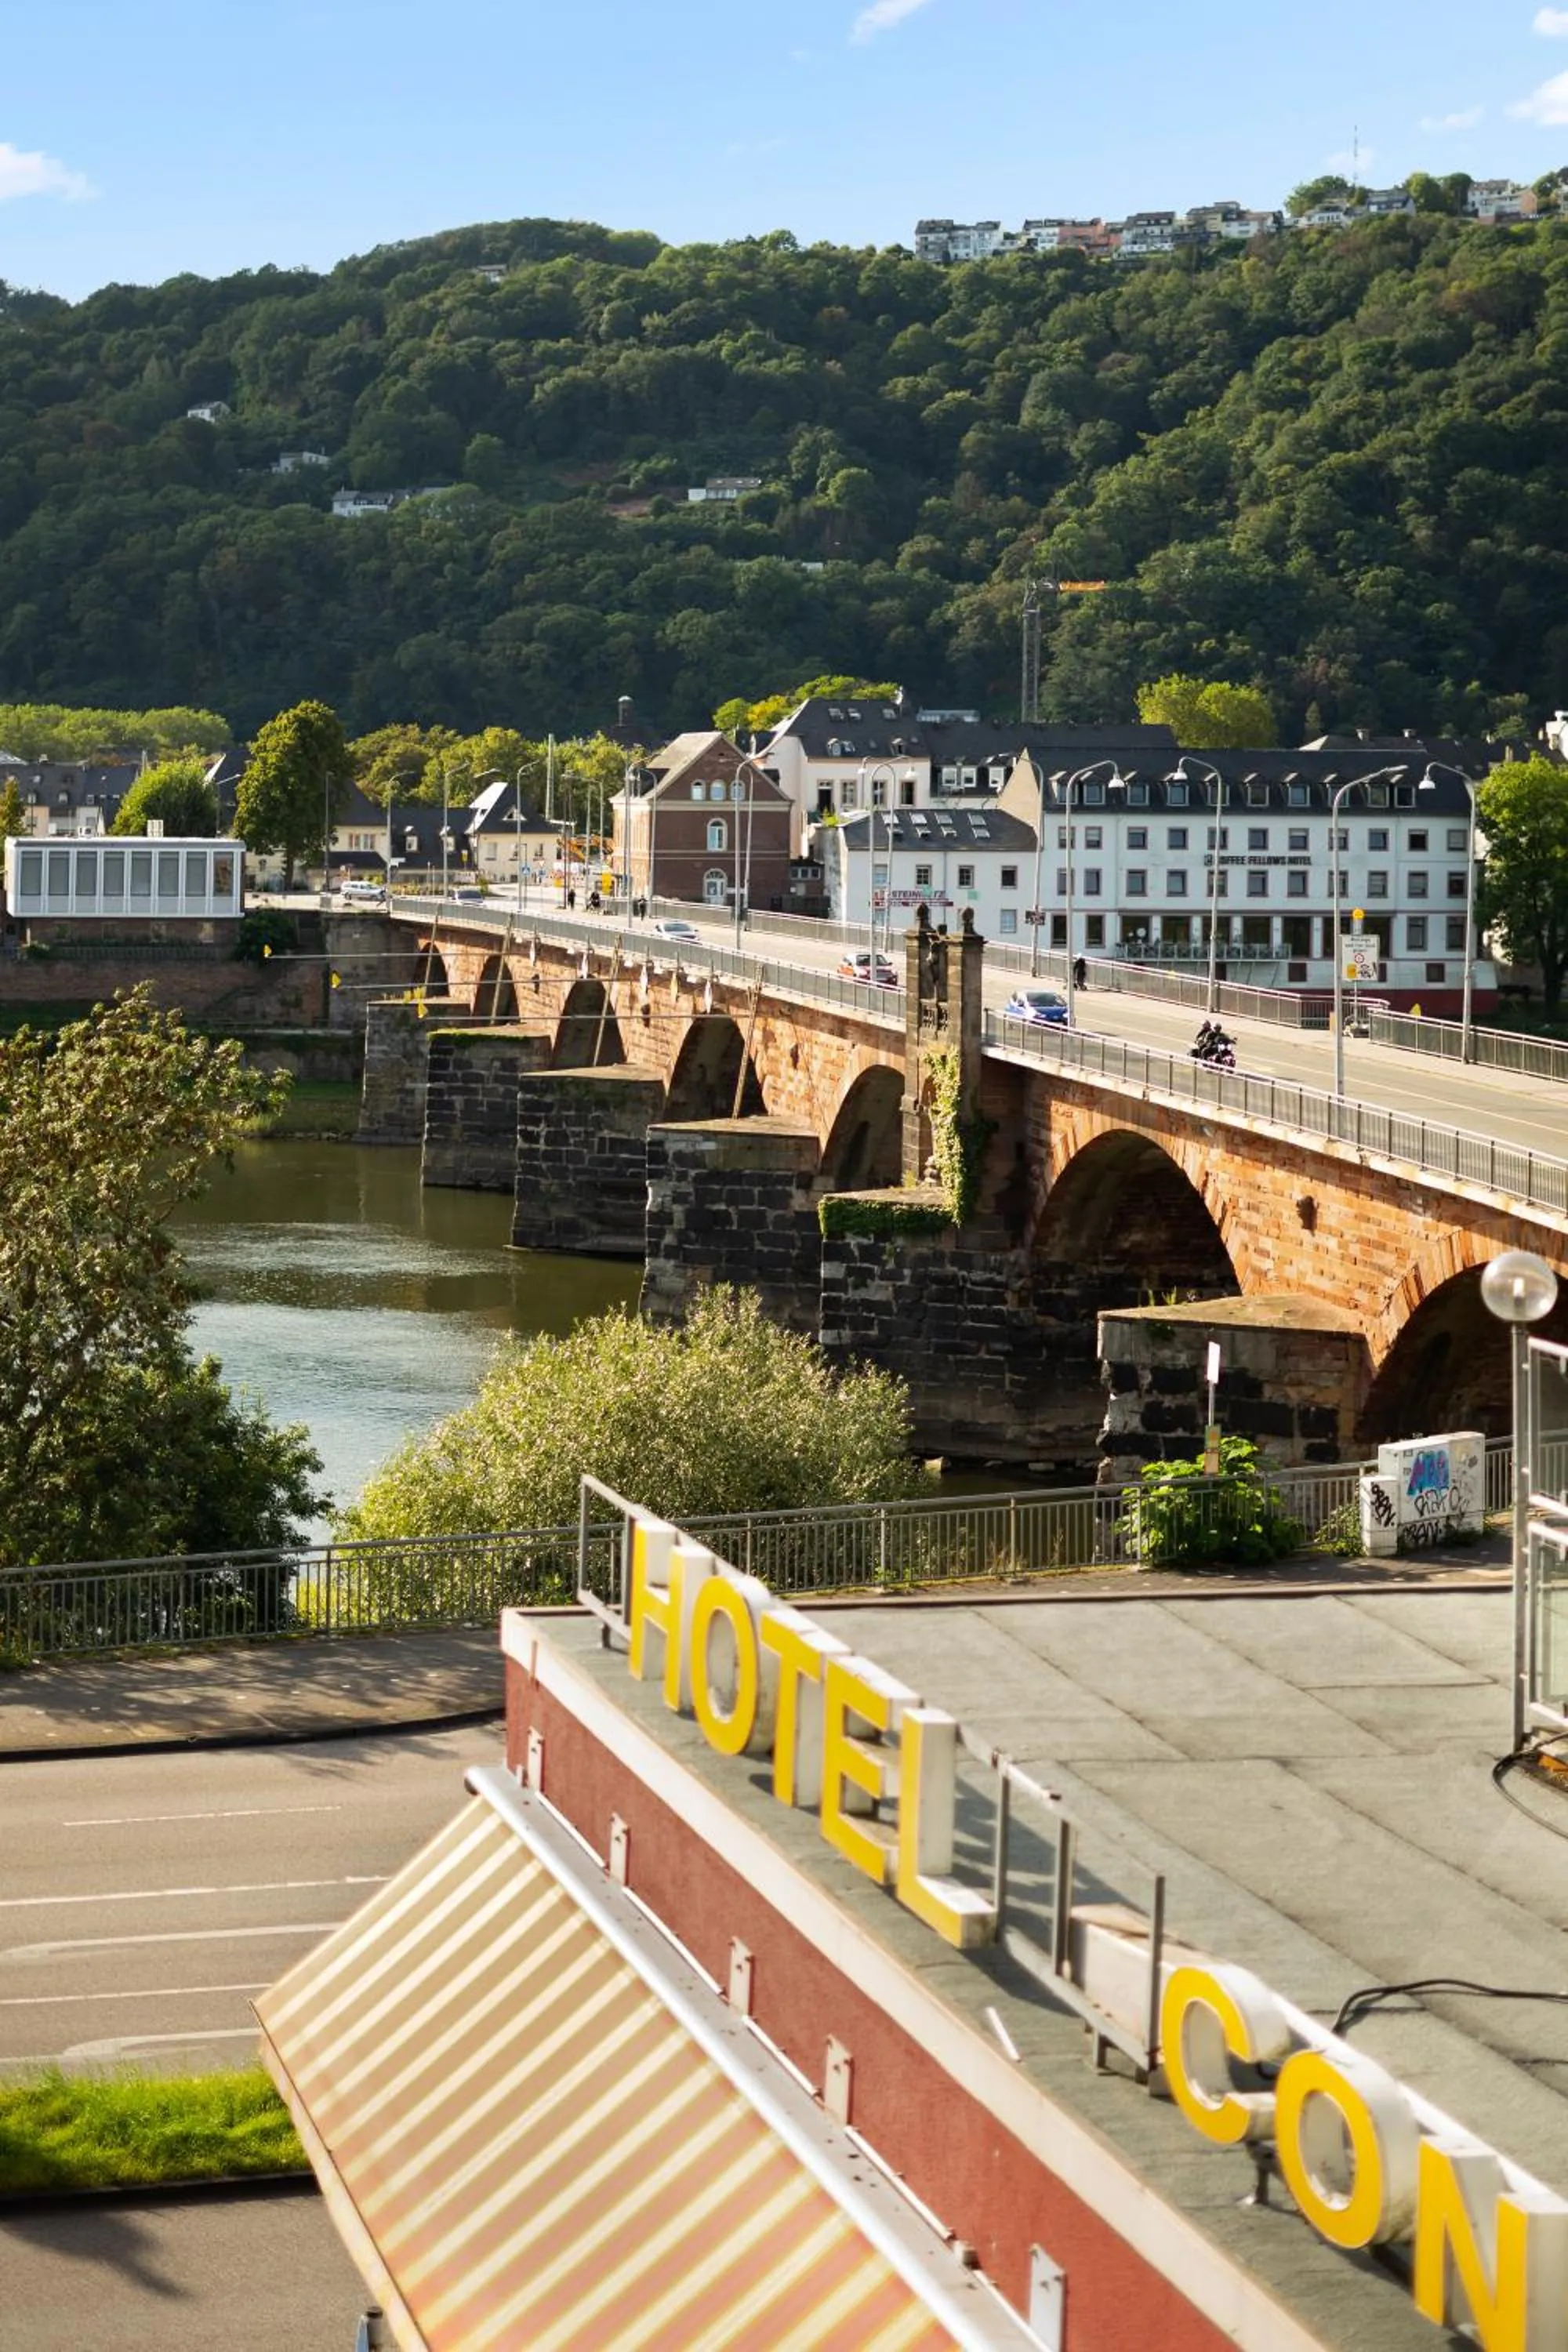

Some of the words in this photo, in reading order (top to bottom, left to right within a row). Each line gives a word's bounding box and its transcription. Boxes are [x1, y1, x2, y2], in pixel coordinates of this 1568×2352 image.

[1216, 855, 1246, 865] OFFEE
[1247, 855, 1286, 865] FELLOWS
[1287, 855, 1312, 865] HOTEL
[629, 1519, 967, 1949] HOTEL
[1160, 1965, 1529, 2352] CON
